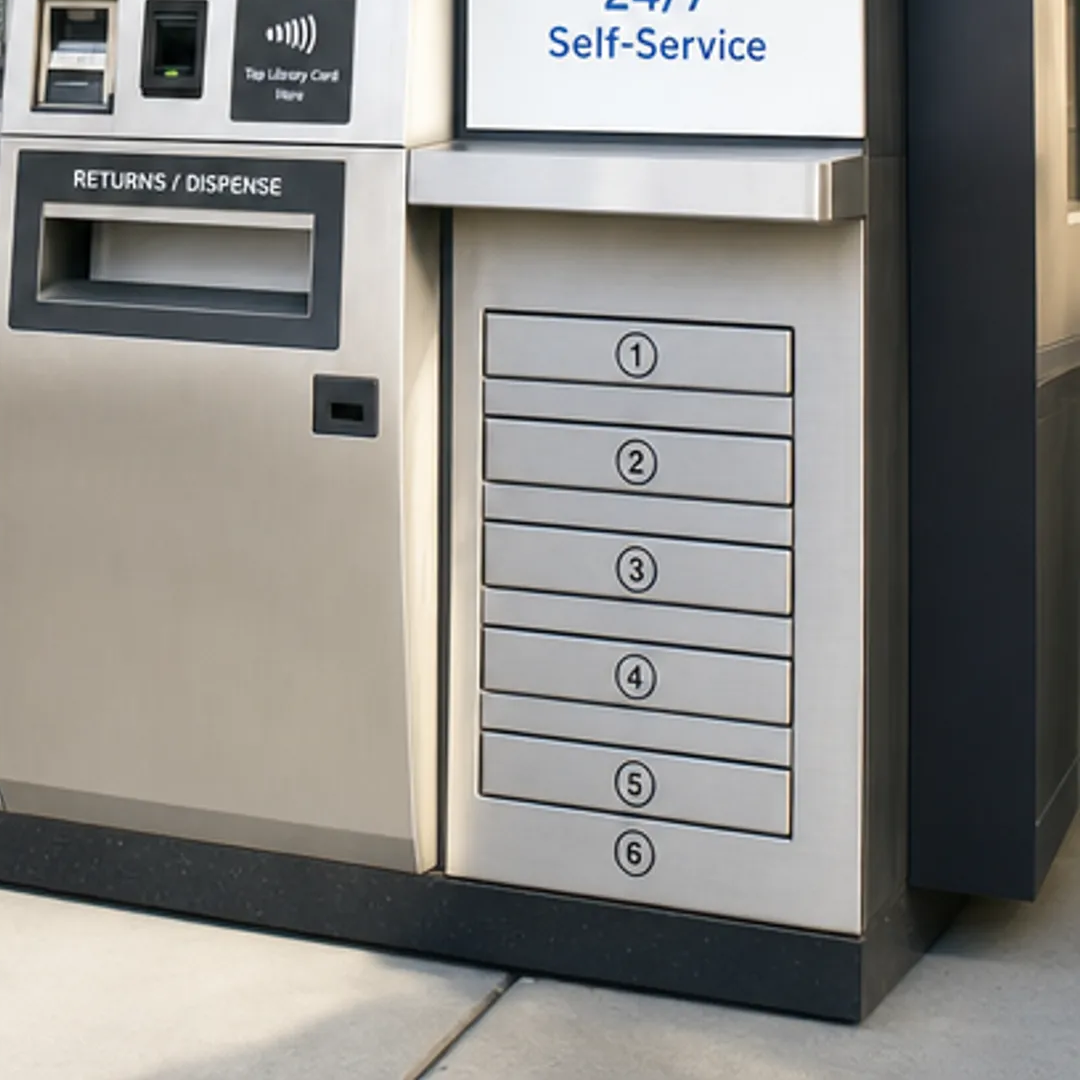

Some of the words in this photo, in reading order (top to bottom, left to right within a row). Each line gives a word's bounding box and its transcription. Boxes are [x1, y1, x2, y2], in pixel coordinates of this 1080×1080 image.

[548, 25, 767, 62] Self-Service
[245, 66, 266, 82] Tap
[267, 67, 308, 84] Library
[310, 68, 340, 83] Card
[73, 169, 167, 192] RETURNS
[171, 173, 182, 192] /
[185, 173, 283, 197] DISPENSE
